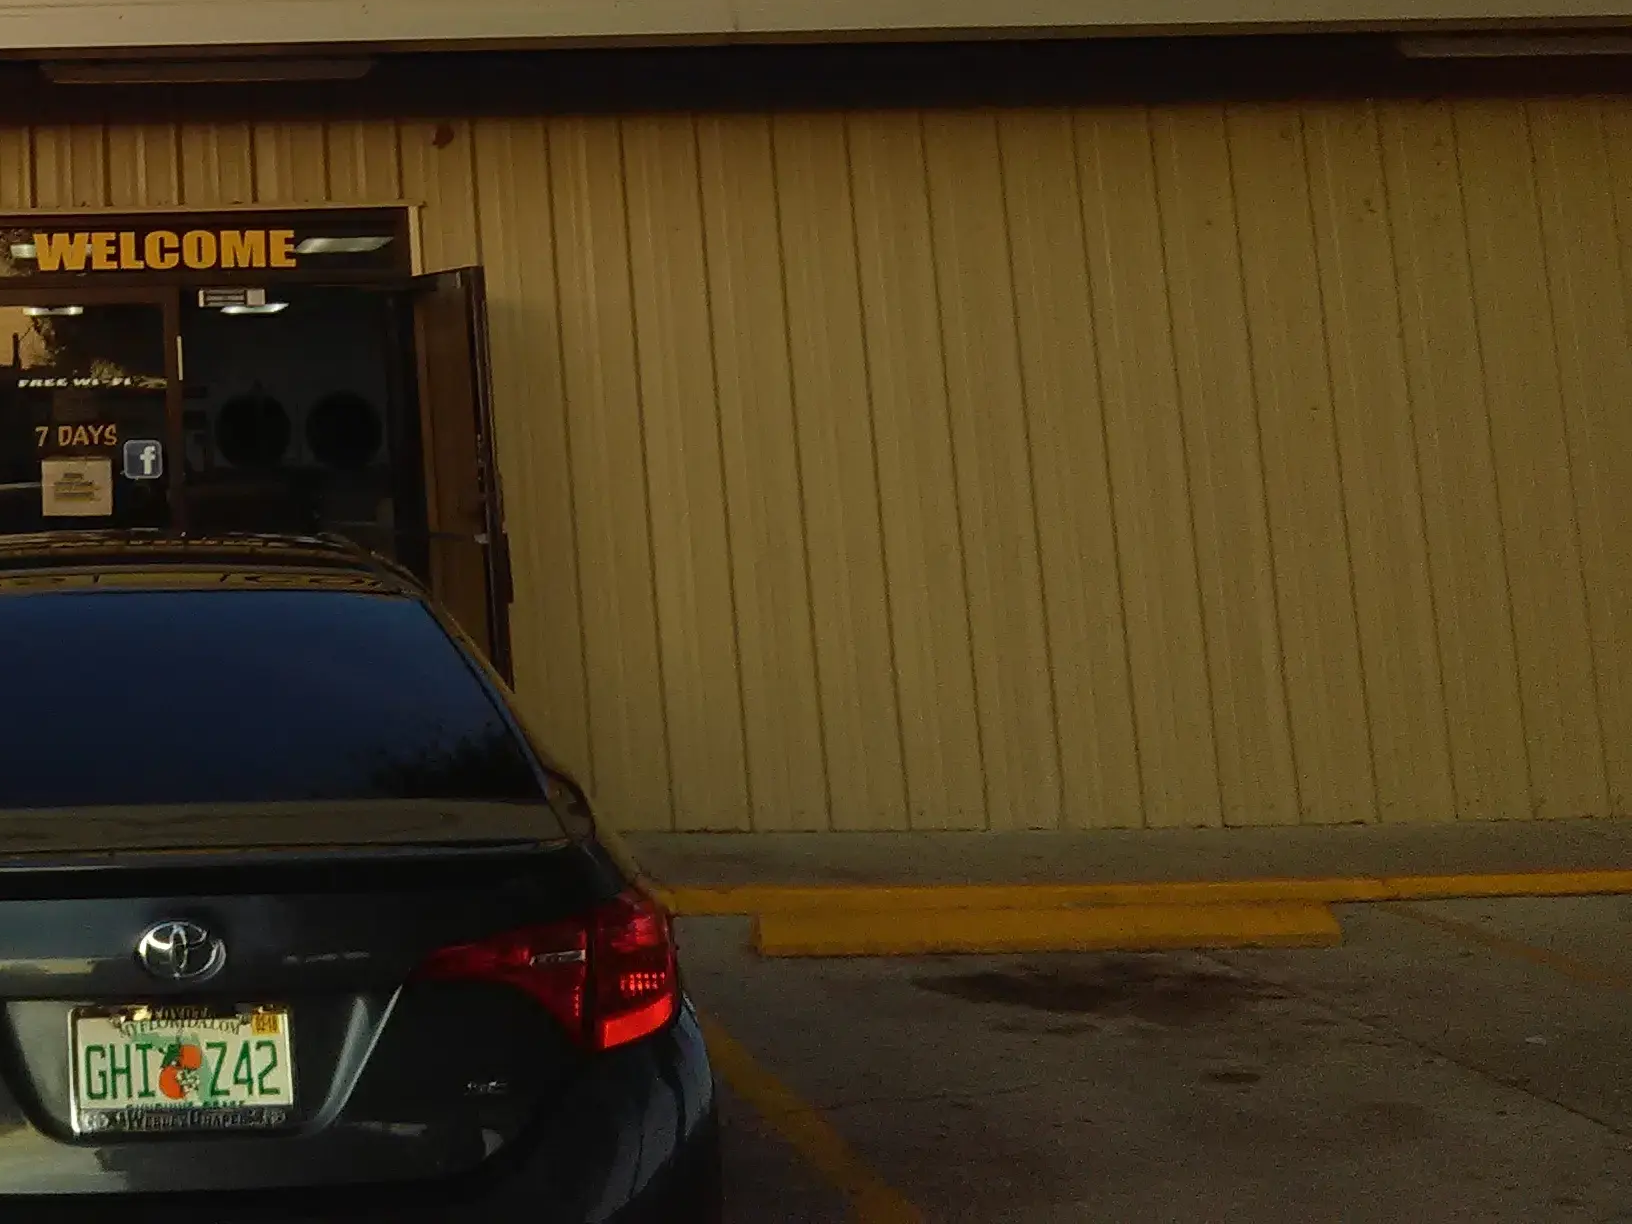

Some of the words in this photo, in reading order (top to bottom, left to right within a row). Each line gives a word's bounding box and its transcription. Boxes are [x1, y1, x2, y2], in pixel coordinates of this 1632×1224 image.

[33, 229, 297, 271] WELCOME
[35, 426, 49, 447] 7
[58, 424, 118, 447] DAYS
[84, 1042, 156, 1100] GHI
[205, 1039, 281, 1096] Z42
